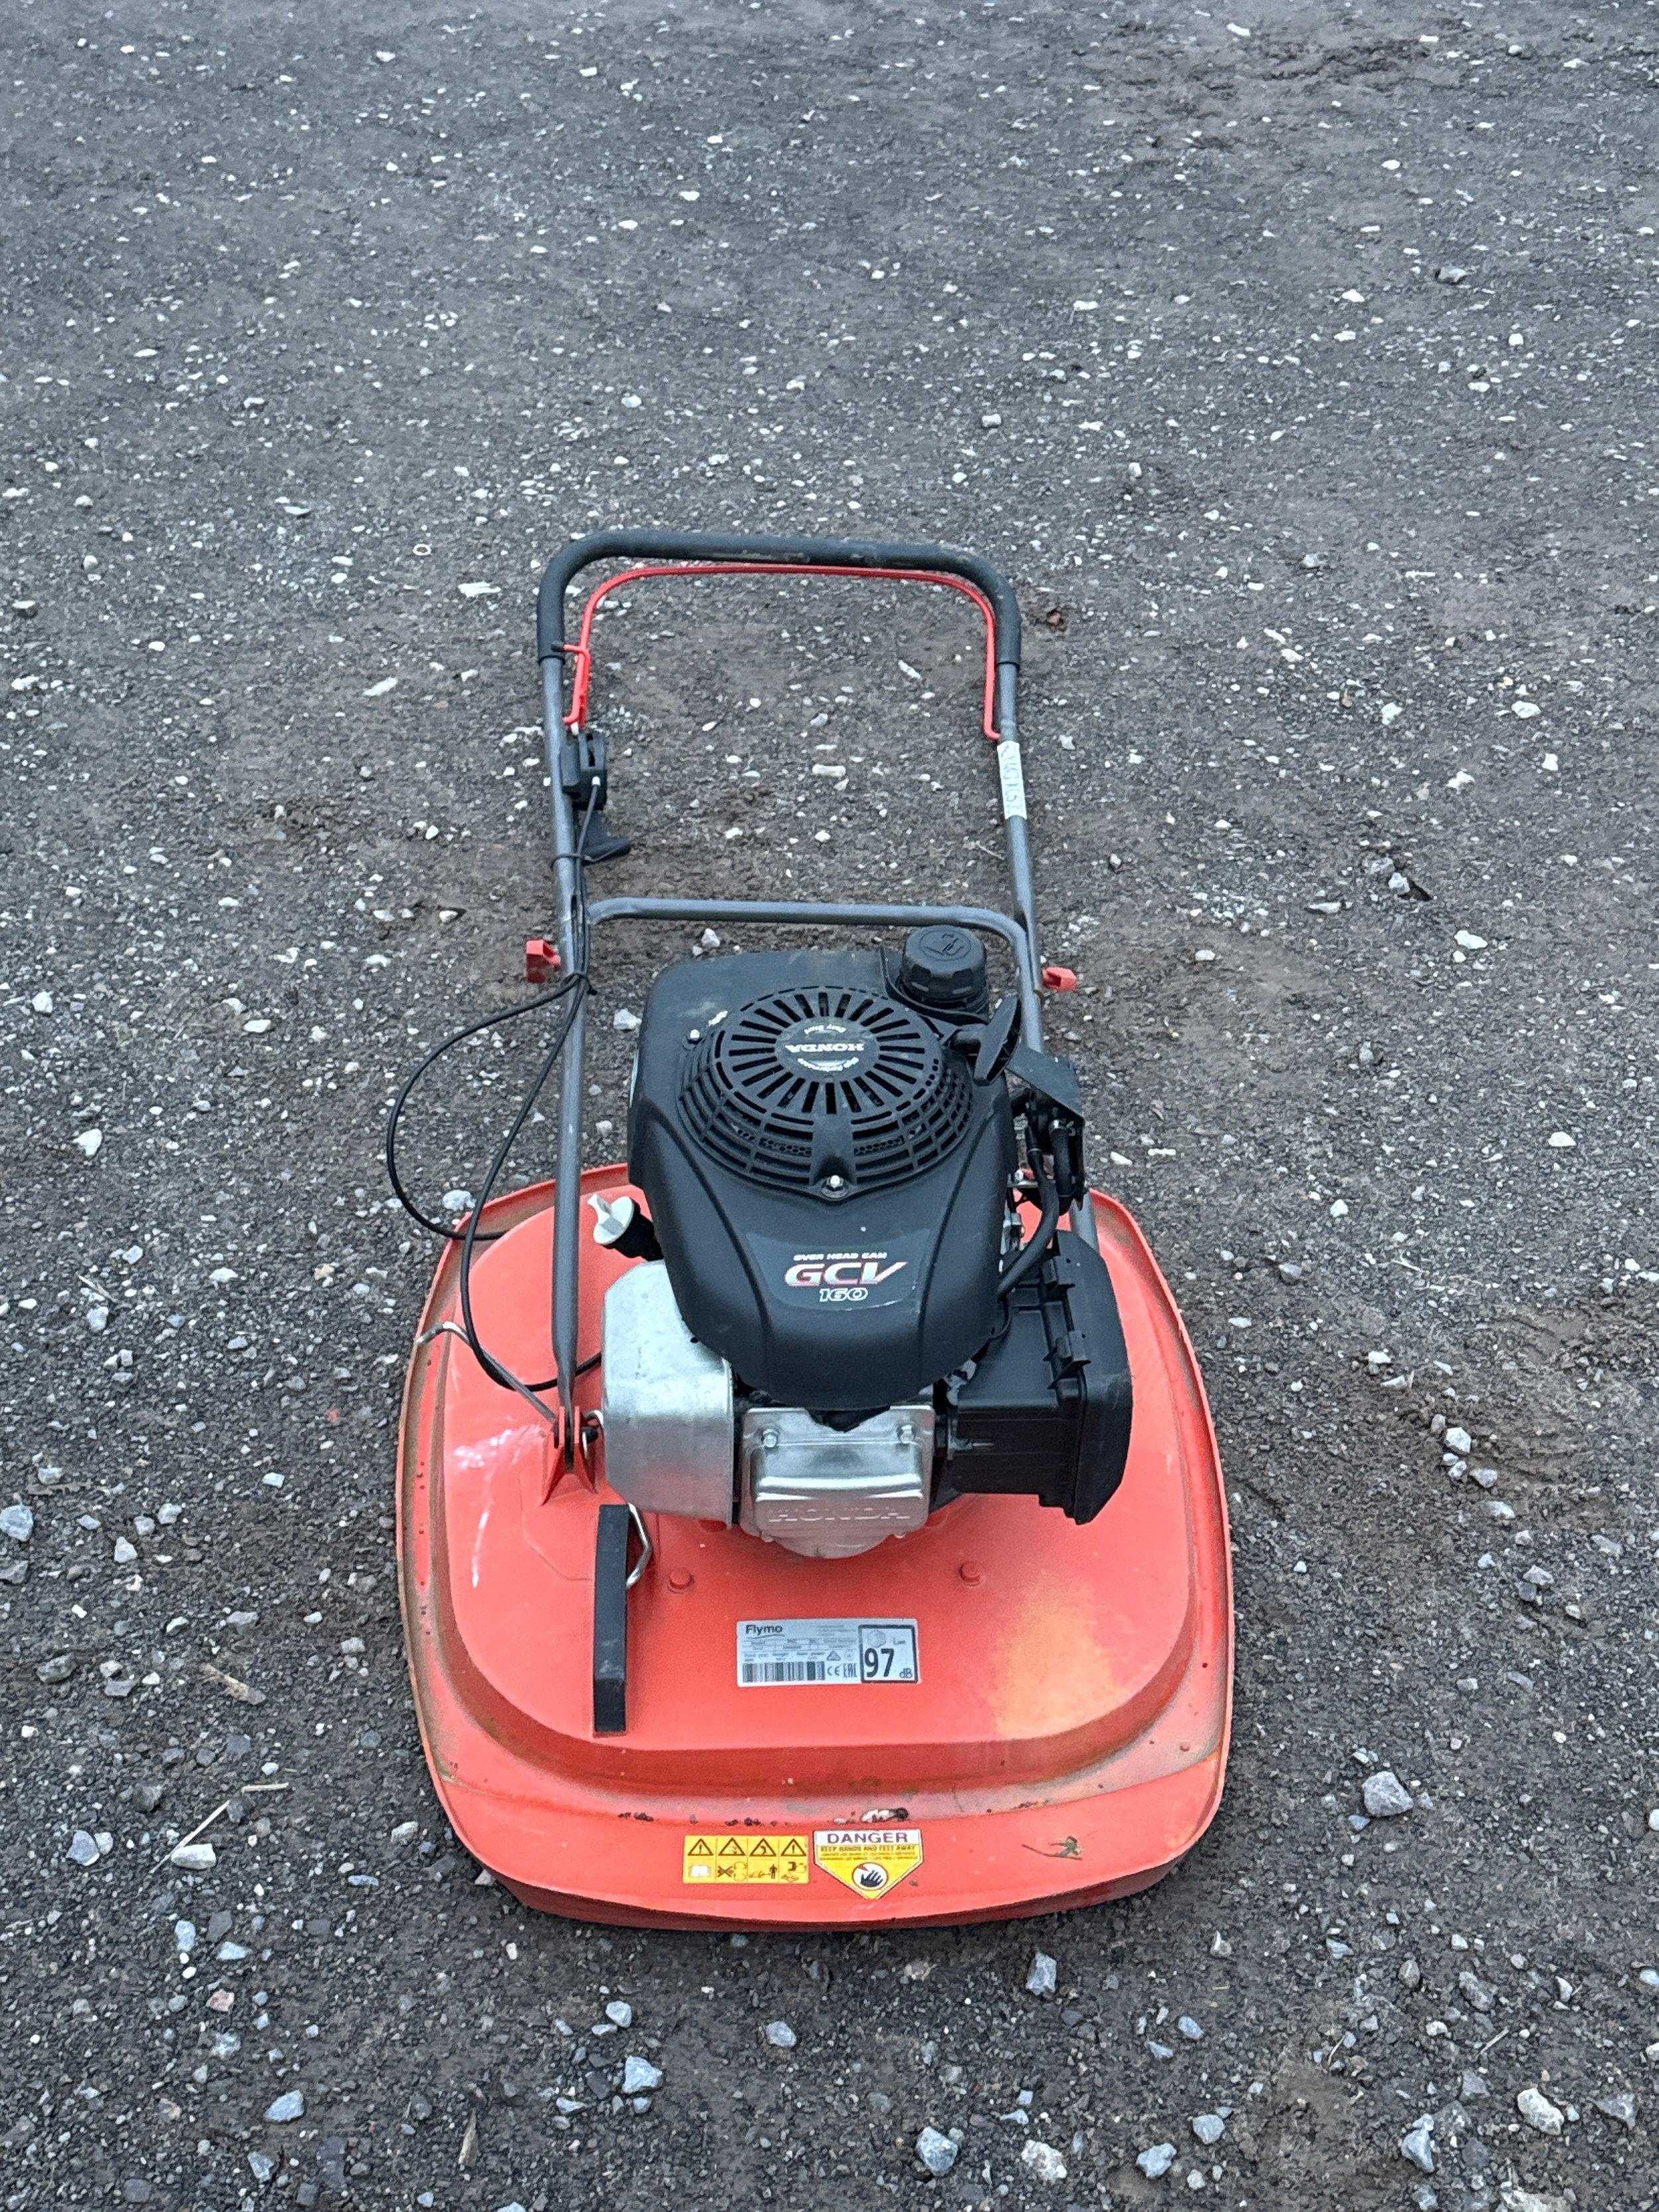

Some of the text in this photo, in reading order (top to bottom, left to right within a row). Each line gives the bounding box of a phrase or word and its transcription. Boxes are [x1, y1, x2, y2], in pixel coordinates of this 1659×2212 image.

[785, 1043, 865, 1053] HONDA
[784, 1262, 908, 1287] GCV
[819, 1288, 869, 1302] 160
[768, 1507, 910, 1522] HONDA
[745, 1624, 783, 1637] Flymo
[864, 1647, 895, 1678] 97
[899, 1668, 913, 1678] dB
[827, 1832, 908, 1844] DANGER
